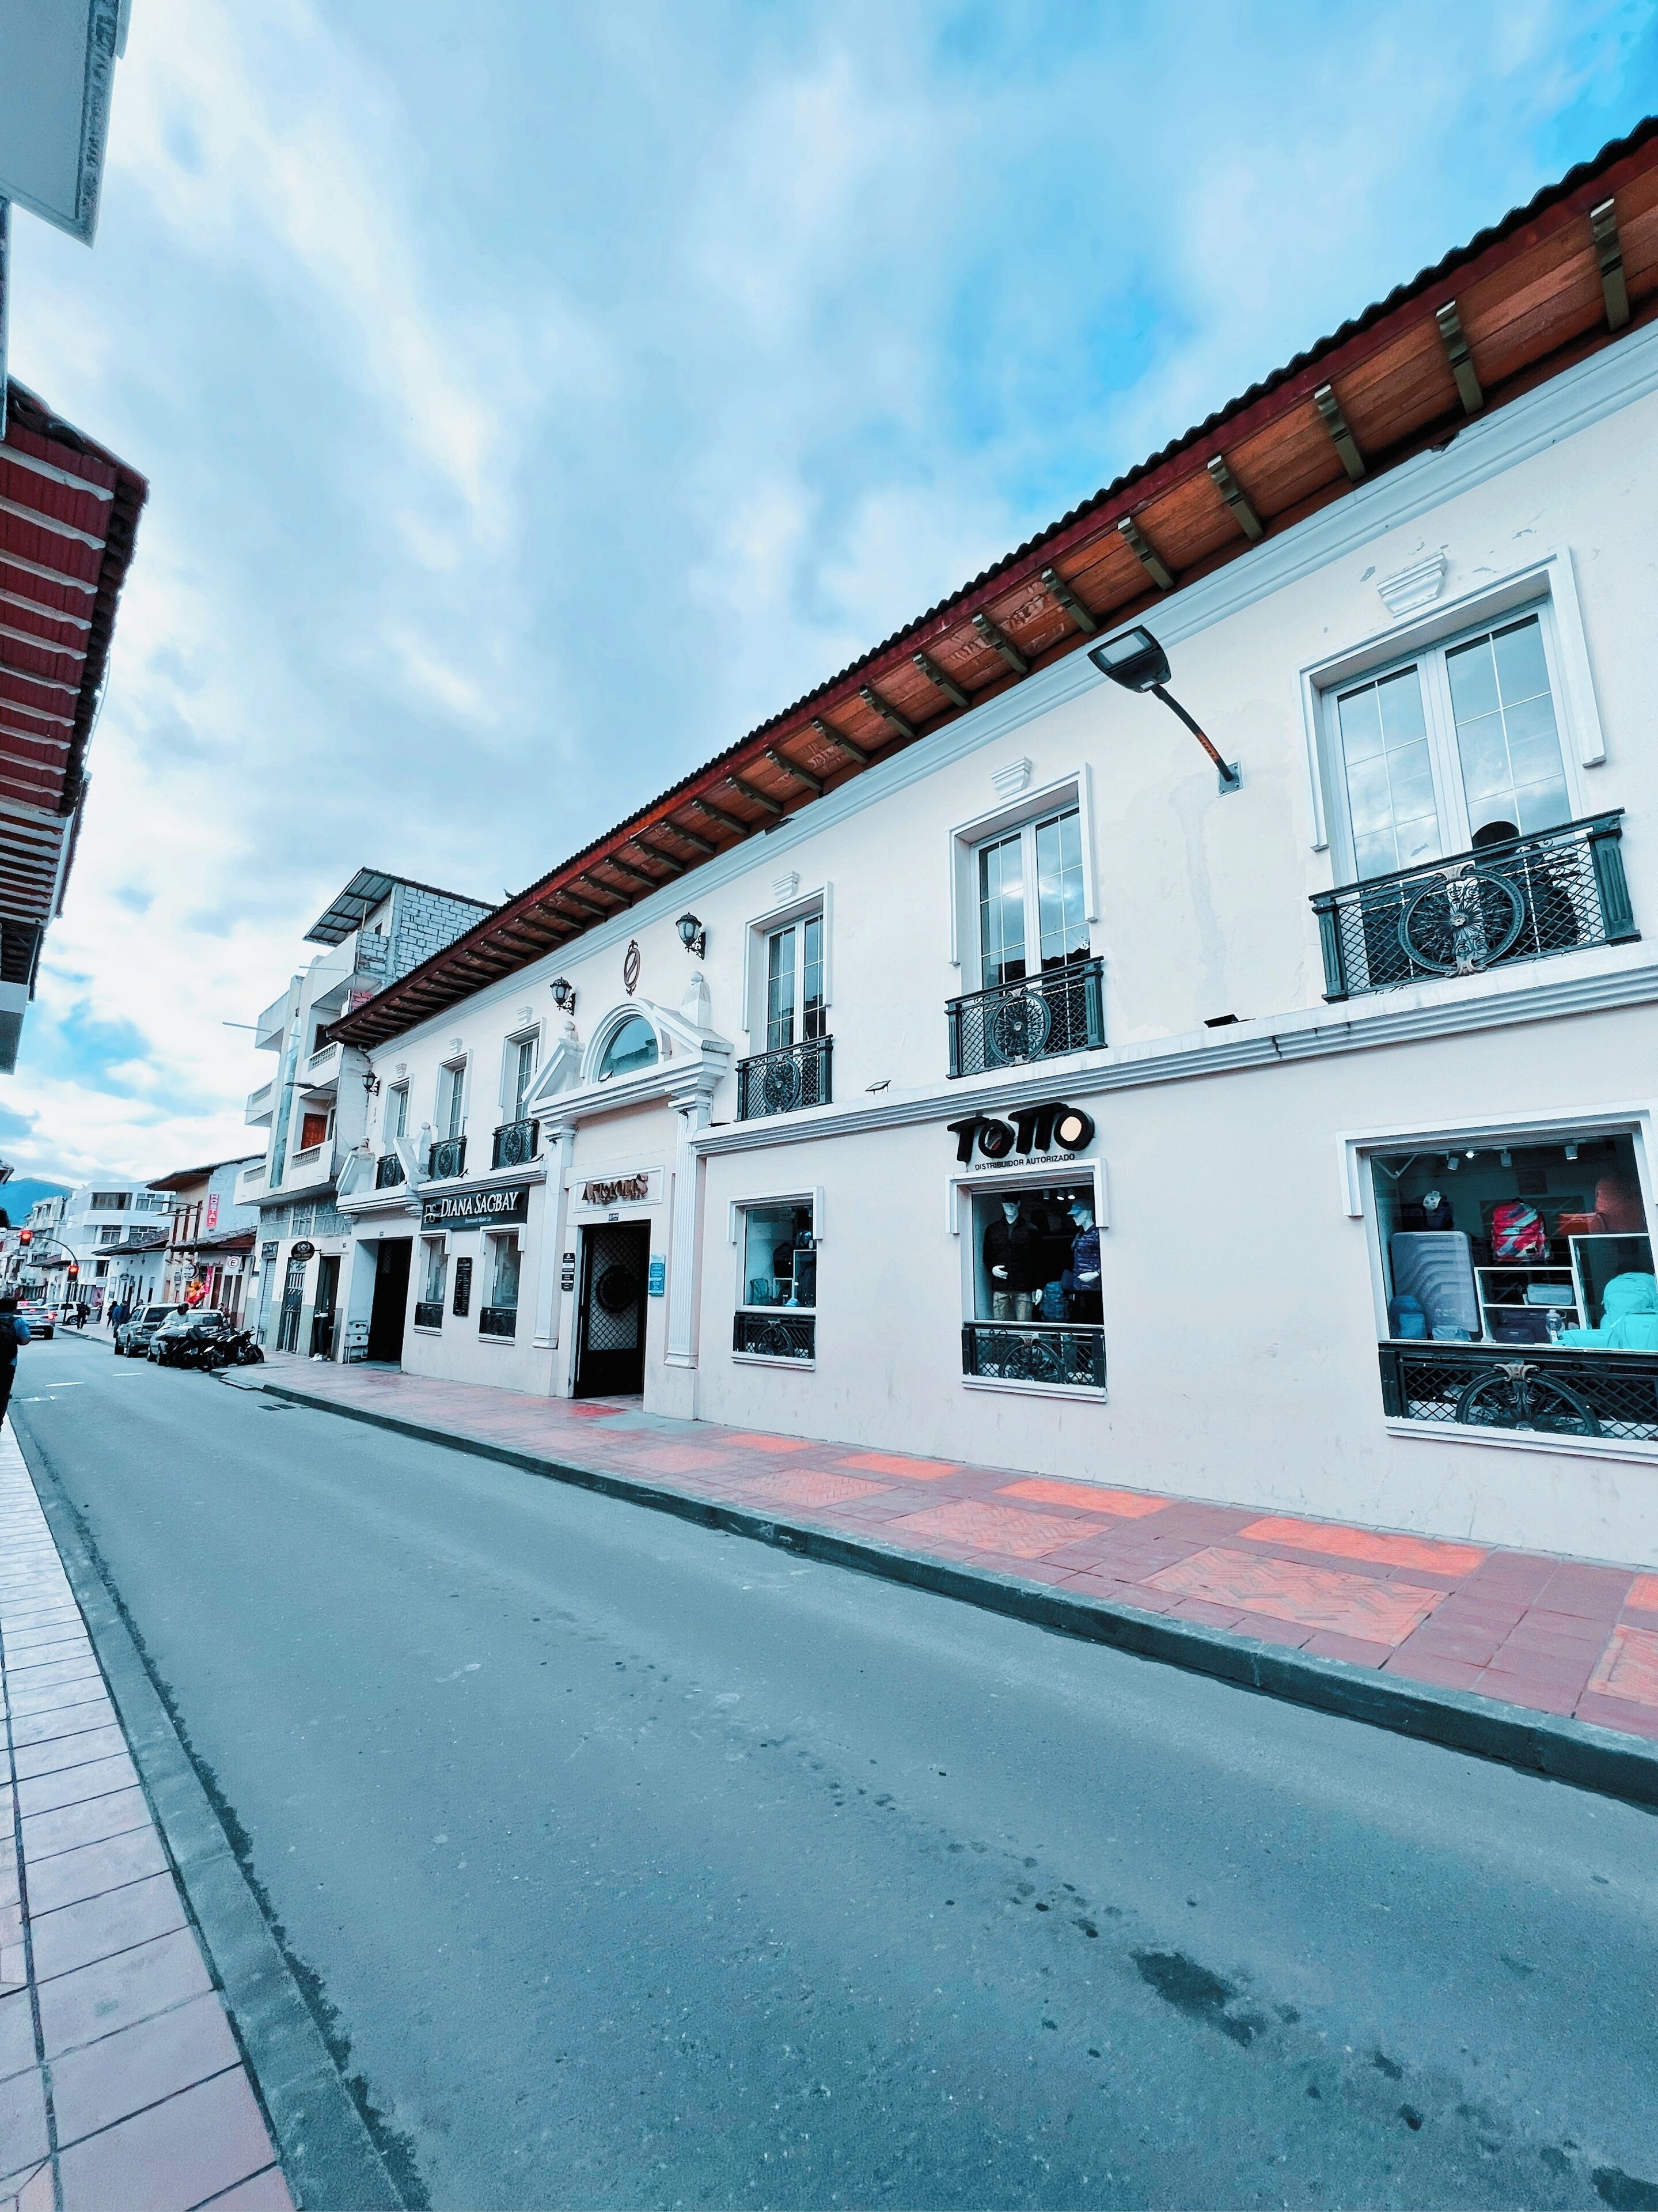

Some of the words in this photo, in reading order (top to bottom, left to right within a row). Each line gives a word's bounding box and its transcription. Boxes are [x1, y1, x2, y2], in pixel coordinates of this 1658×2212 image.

[947, 1101, 1095, 1162] TOTTO
[975, 1158, 1024, 1170] DISTRIBUIDOR
[1026, 1153, 1075, 1165] AUTORIZADO
[441, 1196, 473, 1217] DIANA
[475, 1191, 519, 1214] SAGBAY
